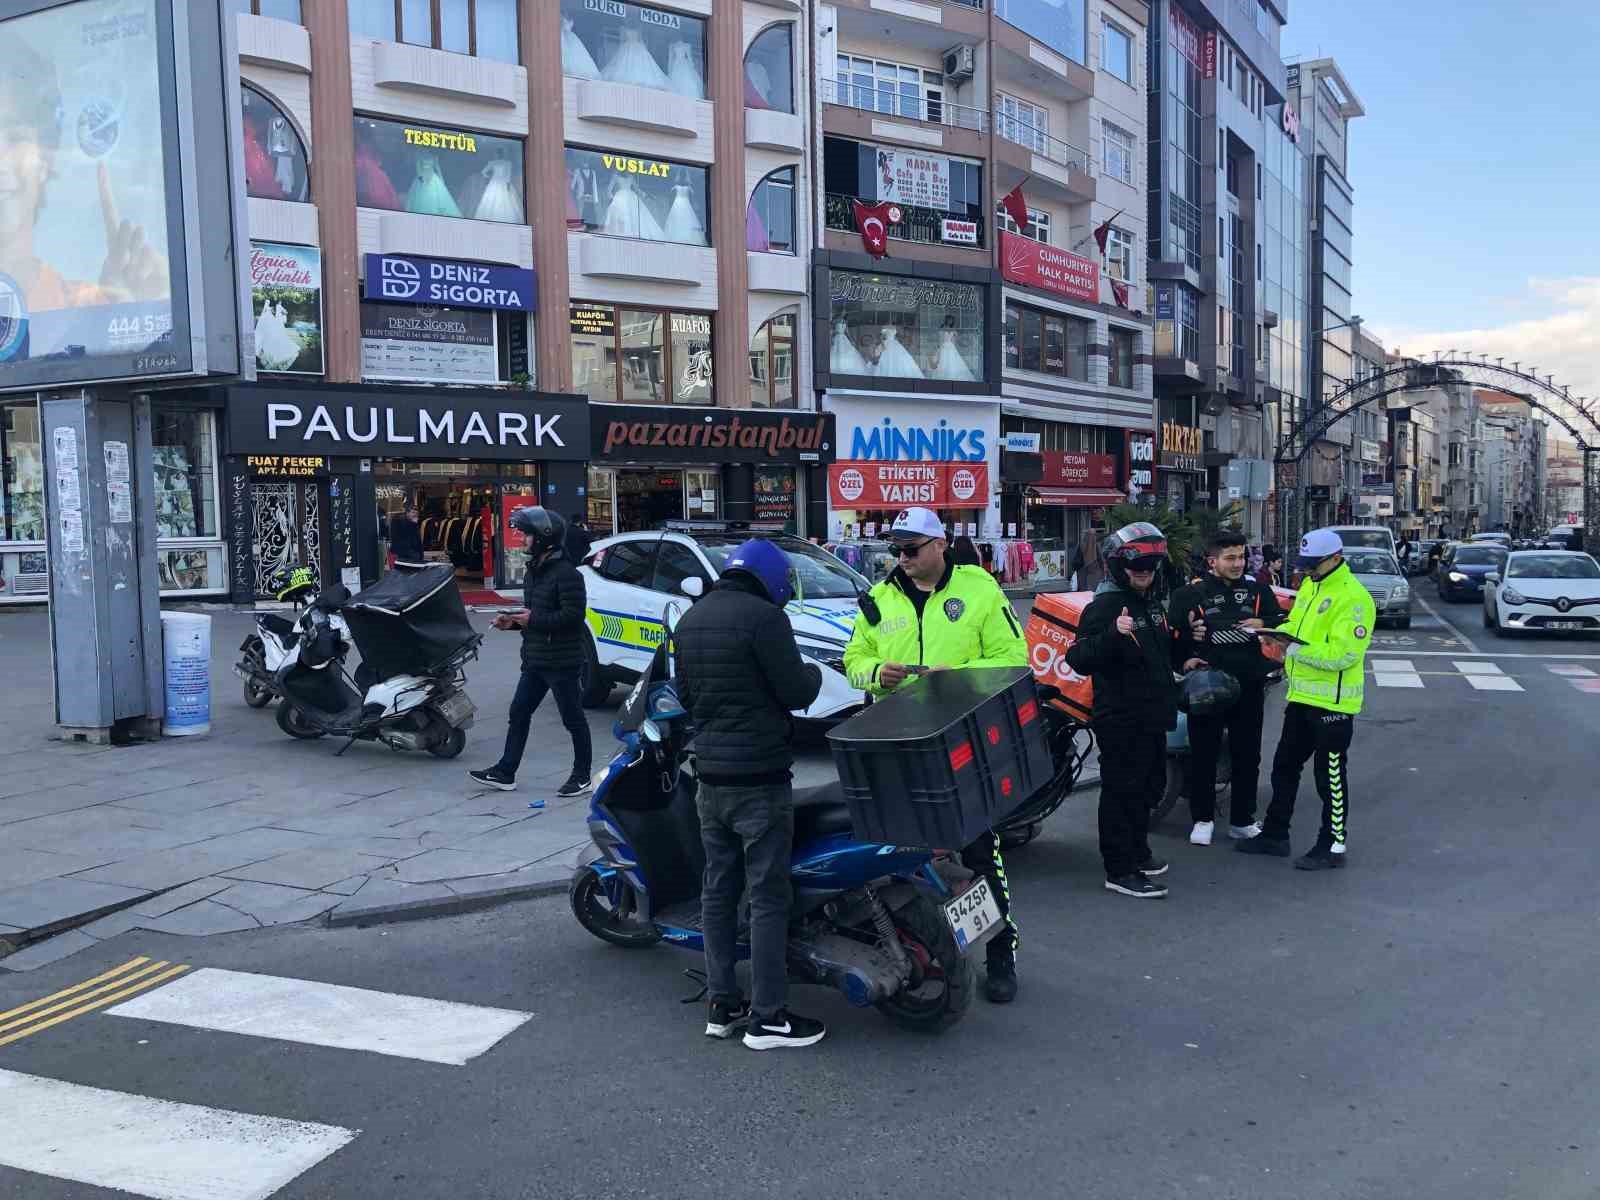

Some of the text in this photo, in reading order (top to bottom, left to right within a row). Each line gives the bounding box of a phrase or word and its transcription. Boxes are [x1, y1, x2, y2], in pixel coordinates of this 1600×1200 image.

[585, 0, 680, 28] DURU MODA
[404, 128, 477, 153] TESETTÜR
[601, 155, 670, 178] VUSLAT
[906, 159, 939, 172] MADAM
[430, 263, 490, 284] DENİZ
[1037, 263, 1061, 280] HALK
[430, 283, 522, 307] SİGORTA
[576, 311, 605, 319] KUAFÖR
[671, 316, 711, 334] KUAFÖR
[107, 316, 141, 336] 444
[267, 402, 565, 447] PAULMARK
[851, 417, 985, 462] MİNNİKS
[247, 456, 324, 468] FUAT PEKER
[1063, 455, 1086, 465] MEYDAN
[257, 467, 316, 476] APT. A BLOK
[878, 463, 936, 480] ETİKETİN
[973, 909, 991, 932] 91
